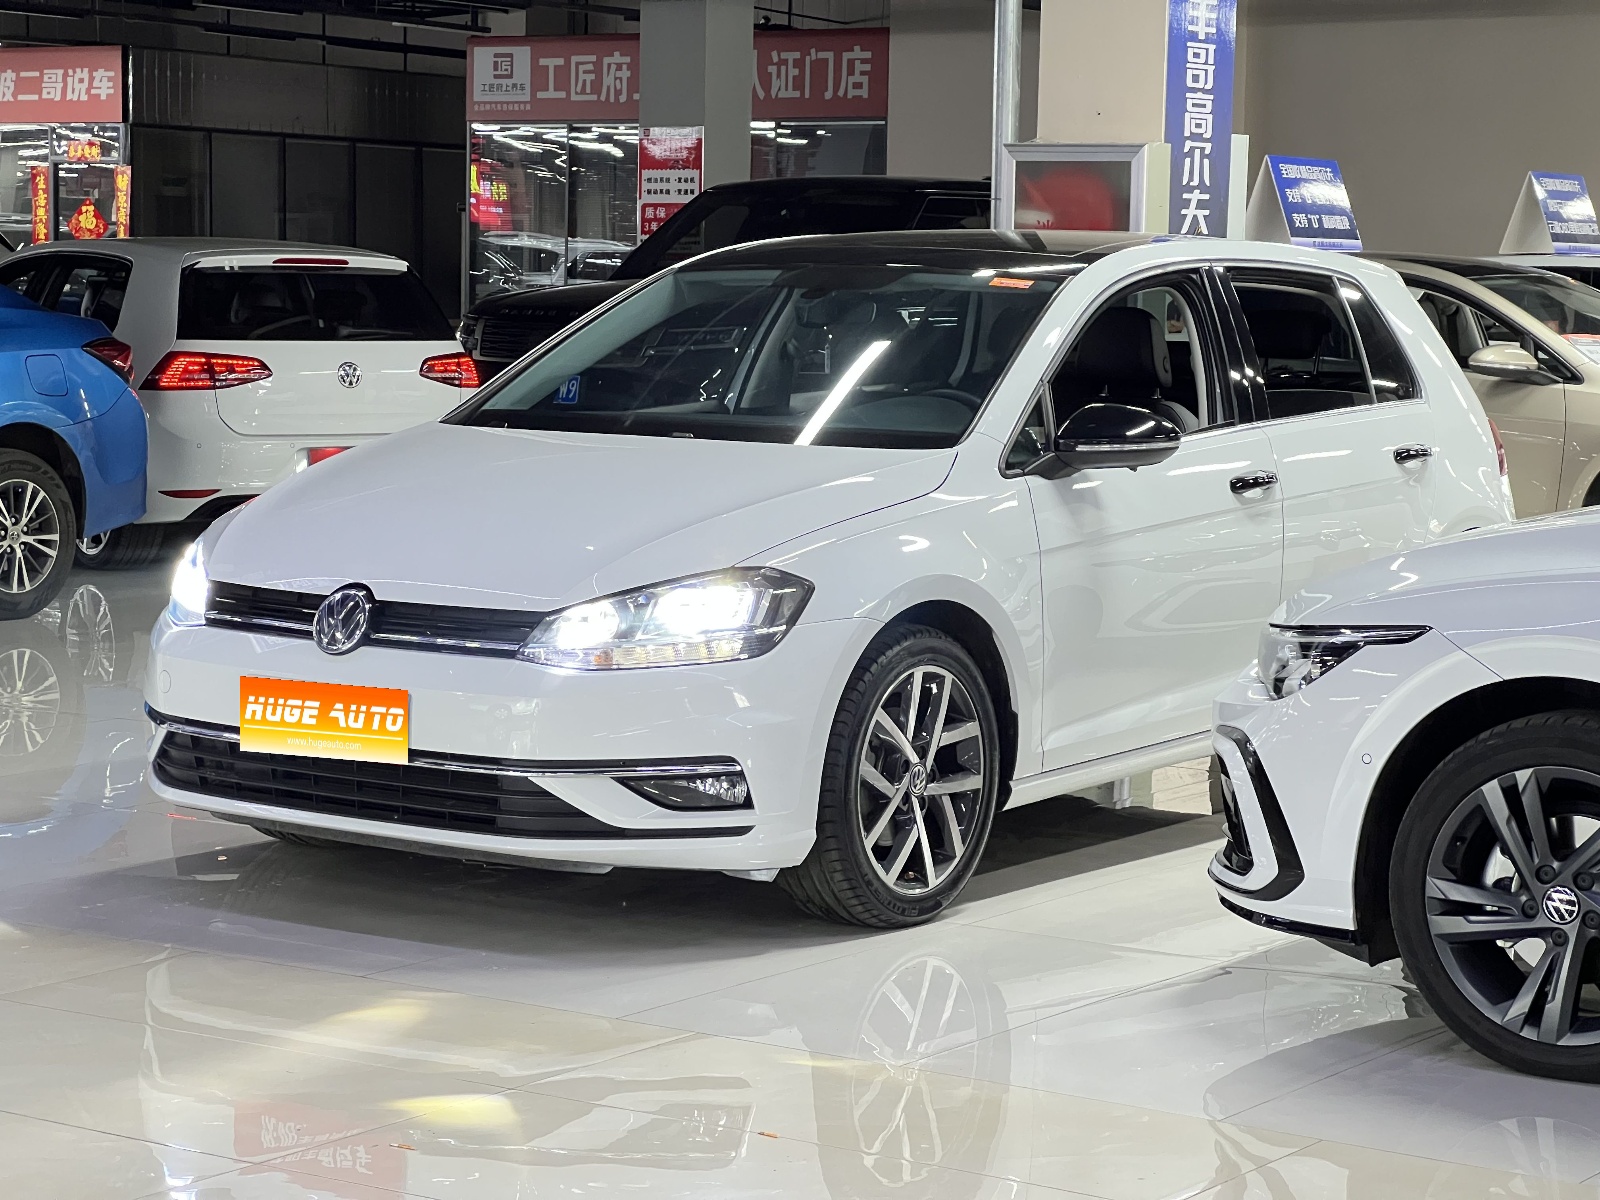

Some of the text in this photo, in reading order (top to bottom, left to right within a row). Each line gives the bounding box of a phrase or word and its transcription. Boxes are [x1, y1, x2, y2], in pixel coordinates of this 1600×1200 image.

[536, 51, 640, 103] 工匠府
[79, 204, 97, 229] 福
[644, 206, 667, 219] 质保
[643, 221, 664, 232] 3年
